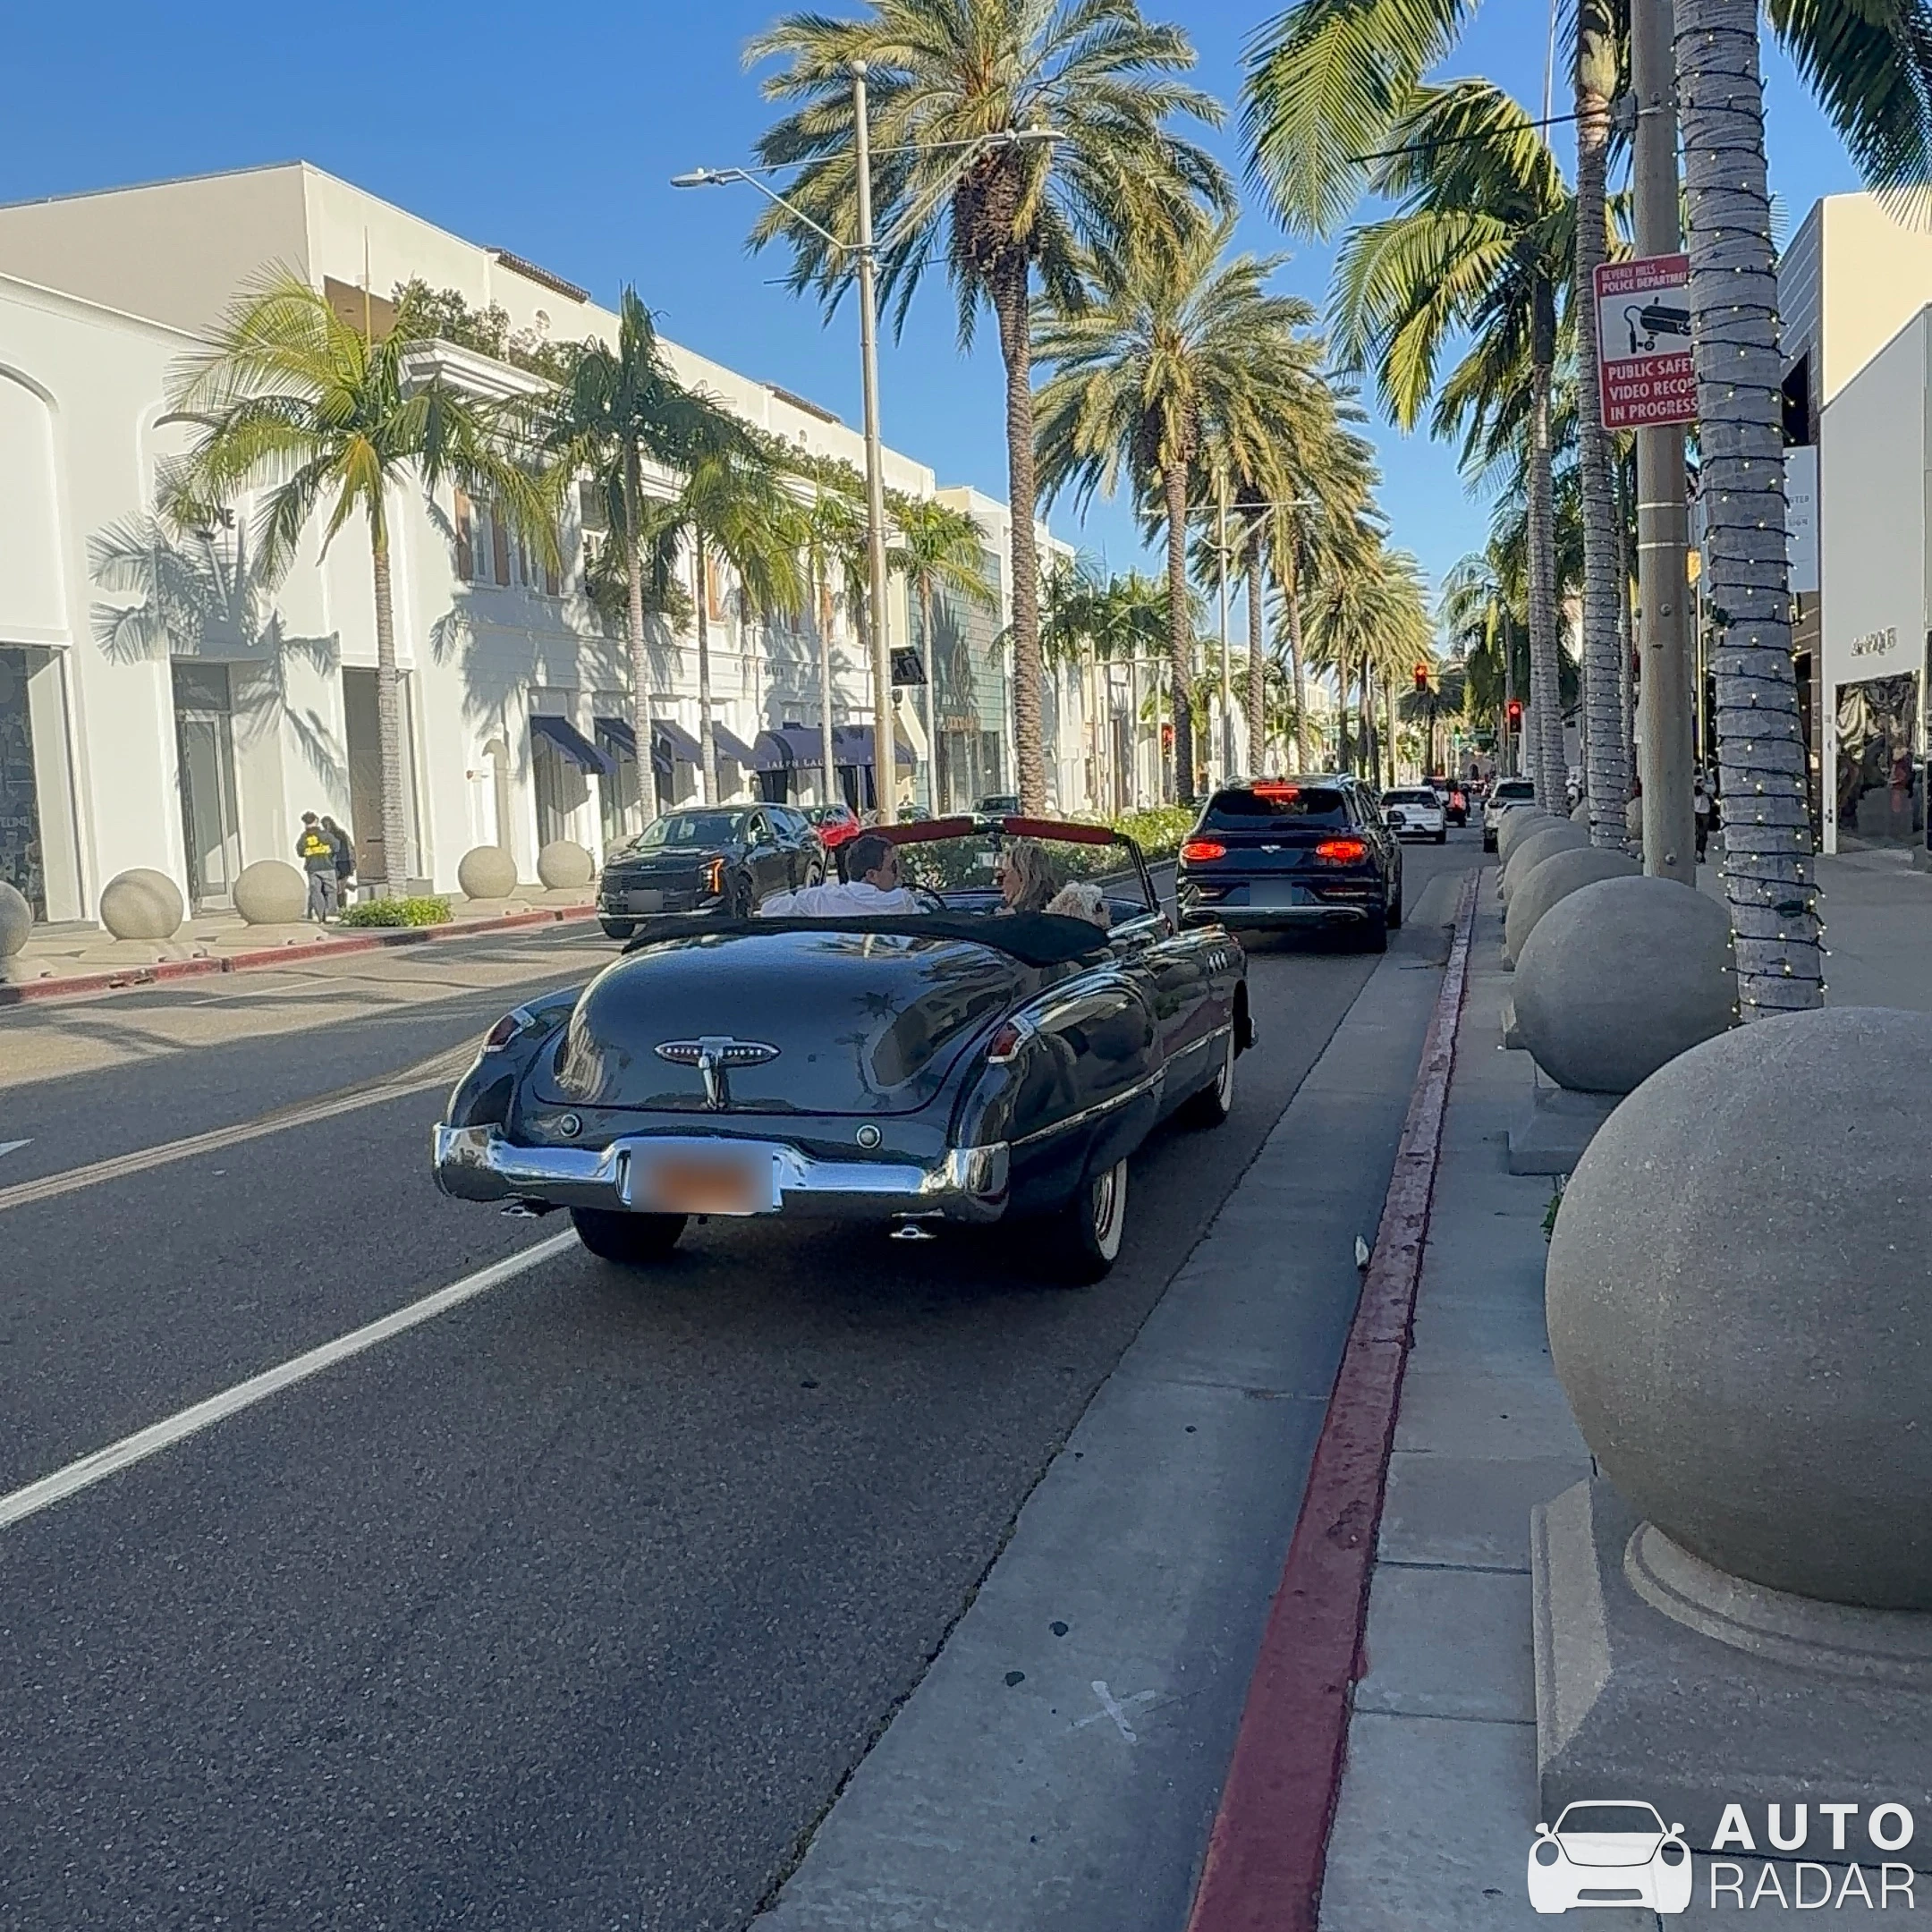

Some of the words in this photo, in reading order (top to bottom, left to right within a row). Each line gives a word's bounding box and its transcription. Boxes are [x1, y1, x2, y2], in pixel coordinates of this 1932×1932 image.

[1601, 267, 1632, 281] BEVERLY
[1636, 264, 1656, 276] HILLS
[1602, 278, 1634, 292] POLICE
[1636, 272, 1686, 287] DEPARTME
[1608, 361, 1654, 381] PUBLIC
[1657, 358, 1694, 376] SAFET
[1609, 383, 1649, 401] VIDEO
[1653, 377, 1696, 396] RECOR
[1611, 405, 1624, 420] IN
[1629, 397, 1698, 419] PROGRESS
